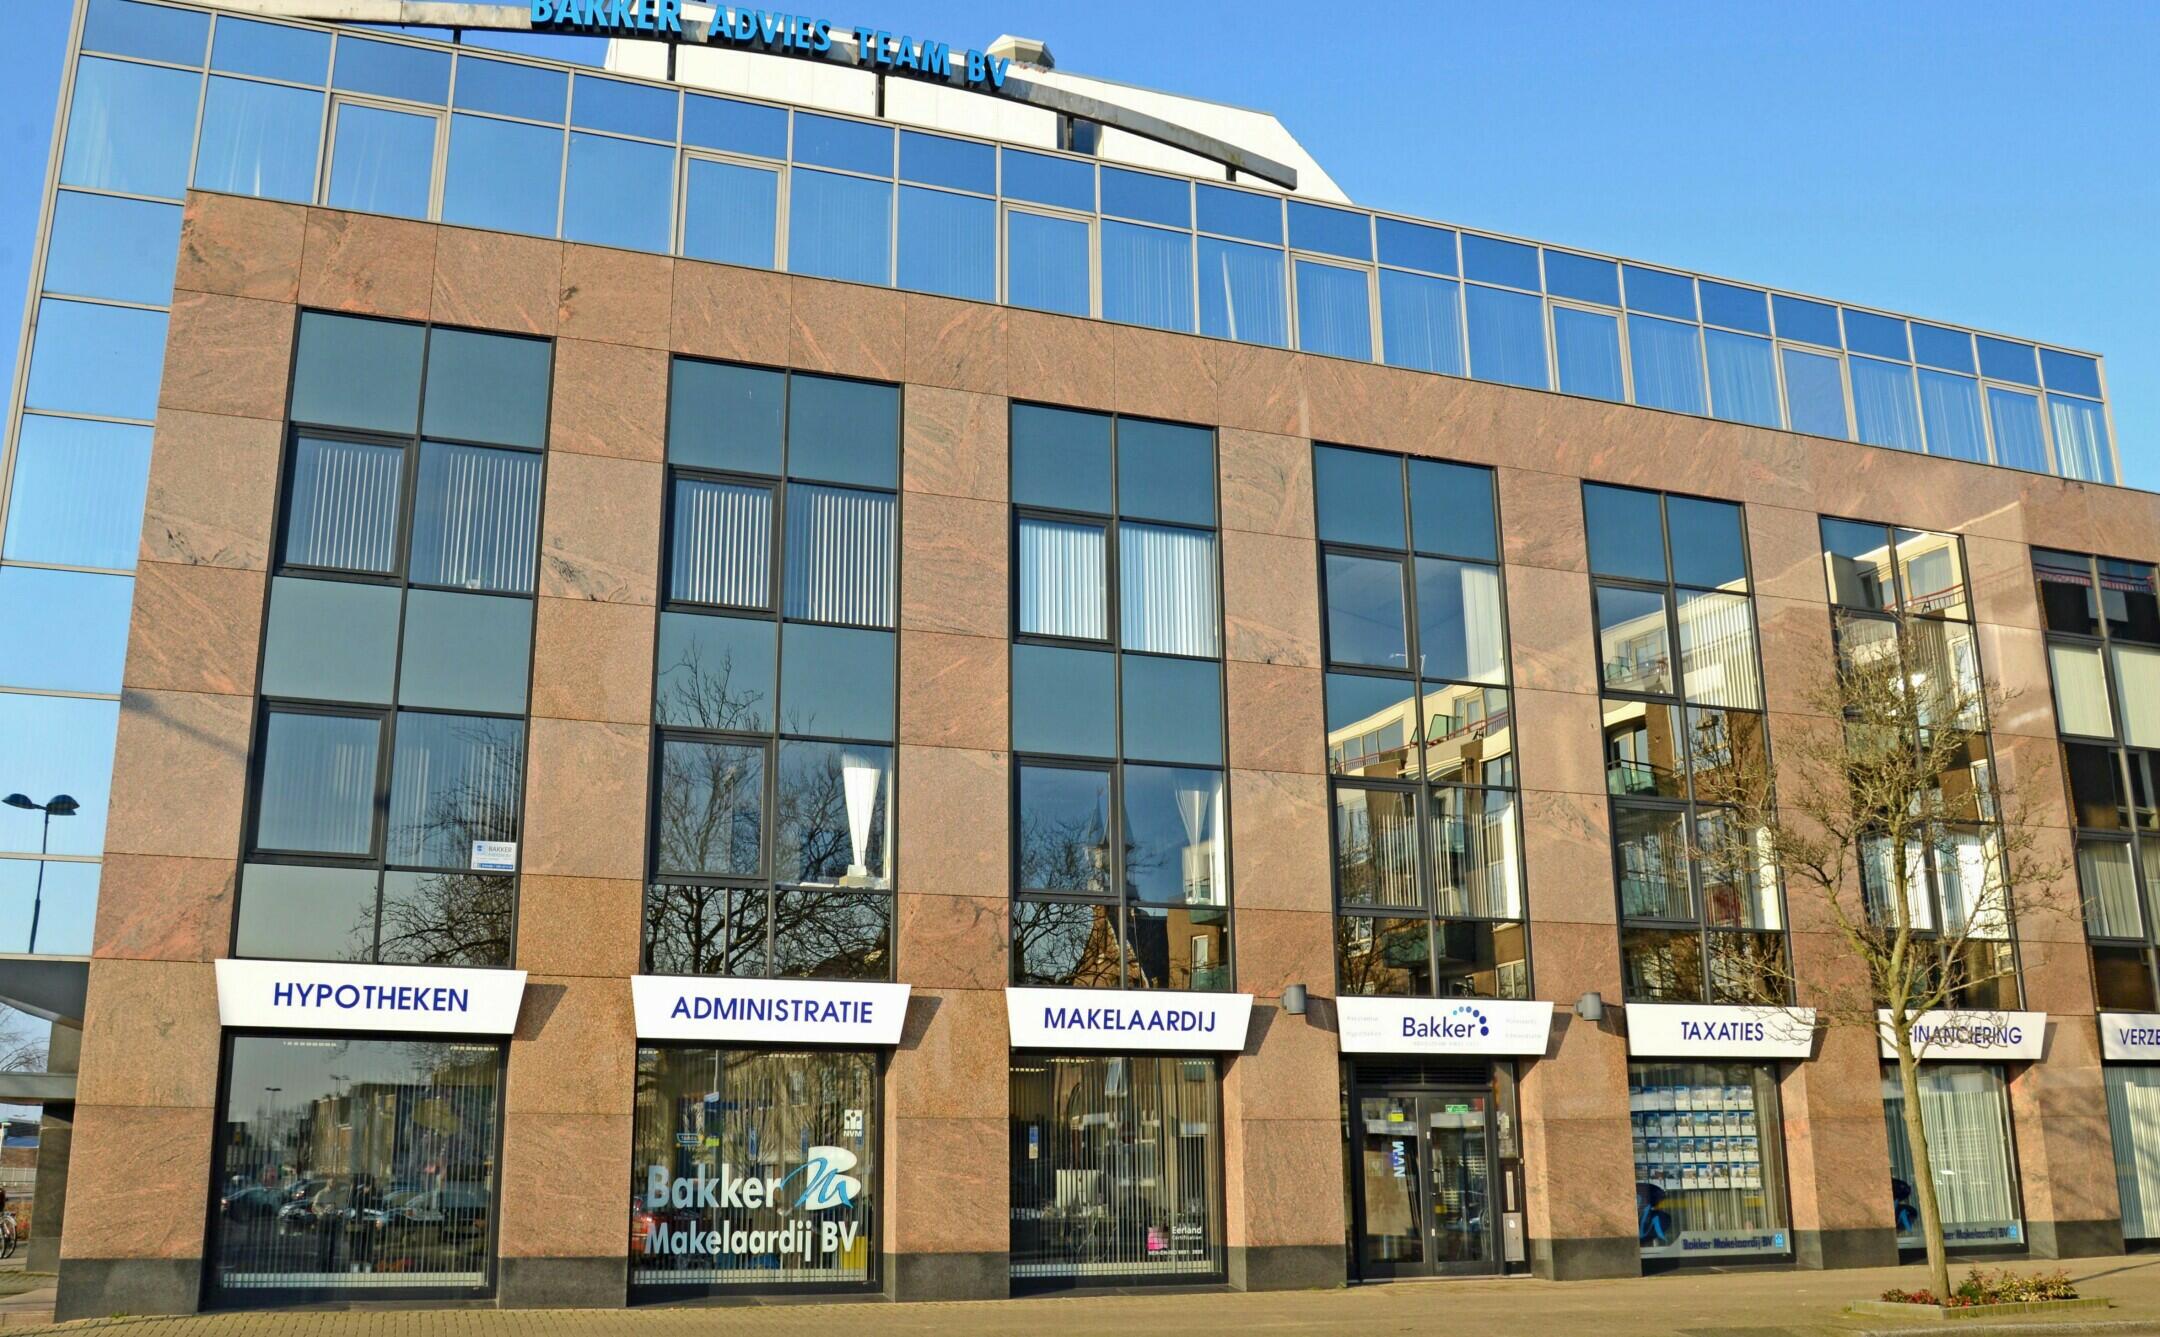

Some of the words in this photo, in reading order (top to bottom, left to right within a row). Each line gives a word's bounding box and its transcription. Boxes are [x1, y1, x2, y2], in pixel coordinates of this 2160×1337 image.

[530, 0, 683, 32] BAKKER
[708, 7, 832, 51] ADVIES
[853, 26, 951, 77] TEAM
[967, 49, 1011, 88] BV
[273, 982, 469, 1012] HYPOTHEKEN
[671, 996, 873, 1024] ADMINISTRATIE
[1044, 1007, 1216, 1033] MAKELAARDIJ
[1402, 1016, 1475, 1038] Bakker
[1681, 1021, 1764, 1042] TAXATIES
[1909, 1025, 2022, 1044] INANCIERING
[2119, 1028, 2160, 1046] VERZE
[648, 1163, 782, 1209] Bakker
[645, 1220, 812, 1262] Makelaardij
[822, 1221, 859, 1253] BV
